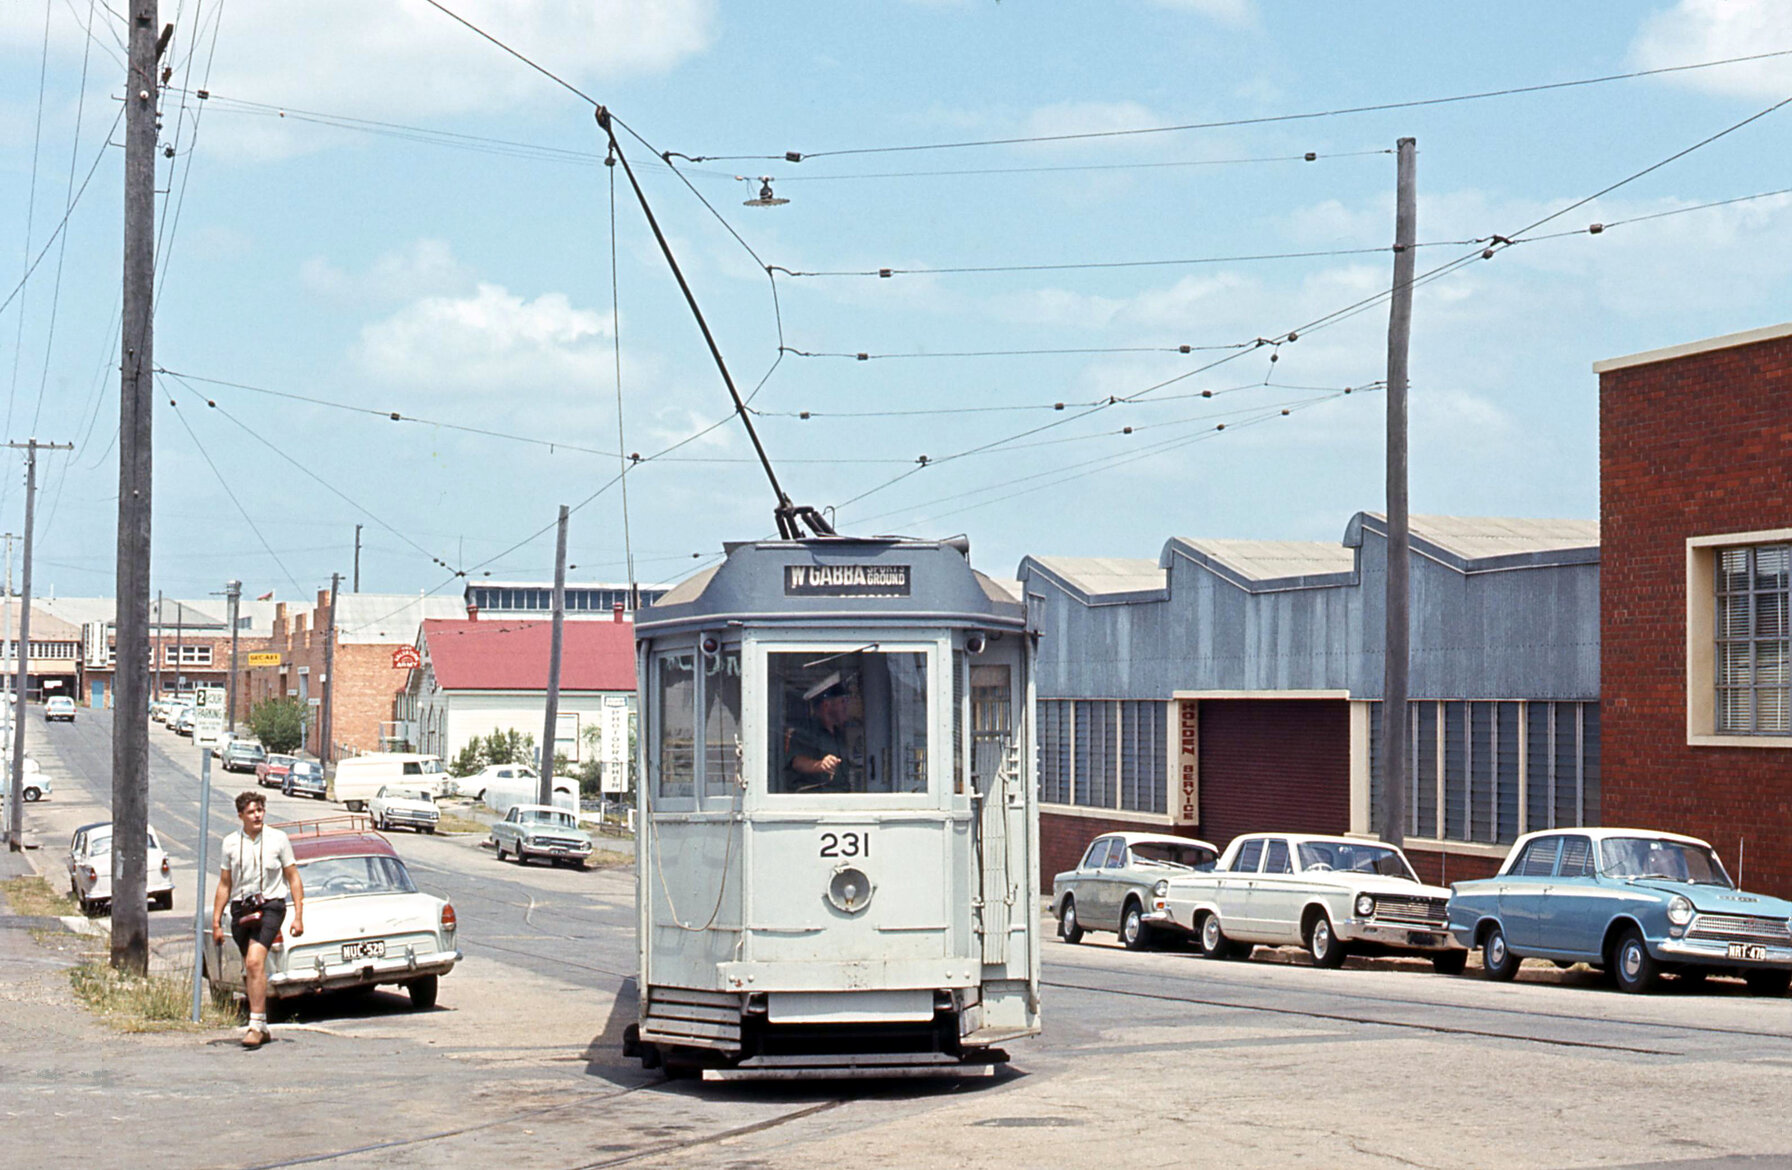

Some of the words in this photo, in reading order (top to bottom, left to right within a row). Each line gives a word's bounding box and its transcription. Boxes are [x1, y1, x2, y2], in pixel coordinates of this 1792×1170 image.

[809, 565, 866, 585] GABBA
[867, 573, 905, 585] GROUND
[198, 690, 205, 704] 2
[206, 694, 222, 704] HOUR
[197, 708, 223, 719] PARKING
[1182, 703, 1195, 755] HOLDEN
[611, 709, 620, 789] PHOTOGRAPHER
[1183, 765, 1194, 820] SERVICE
[820, 832, 869, 857] 231
